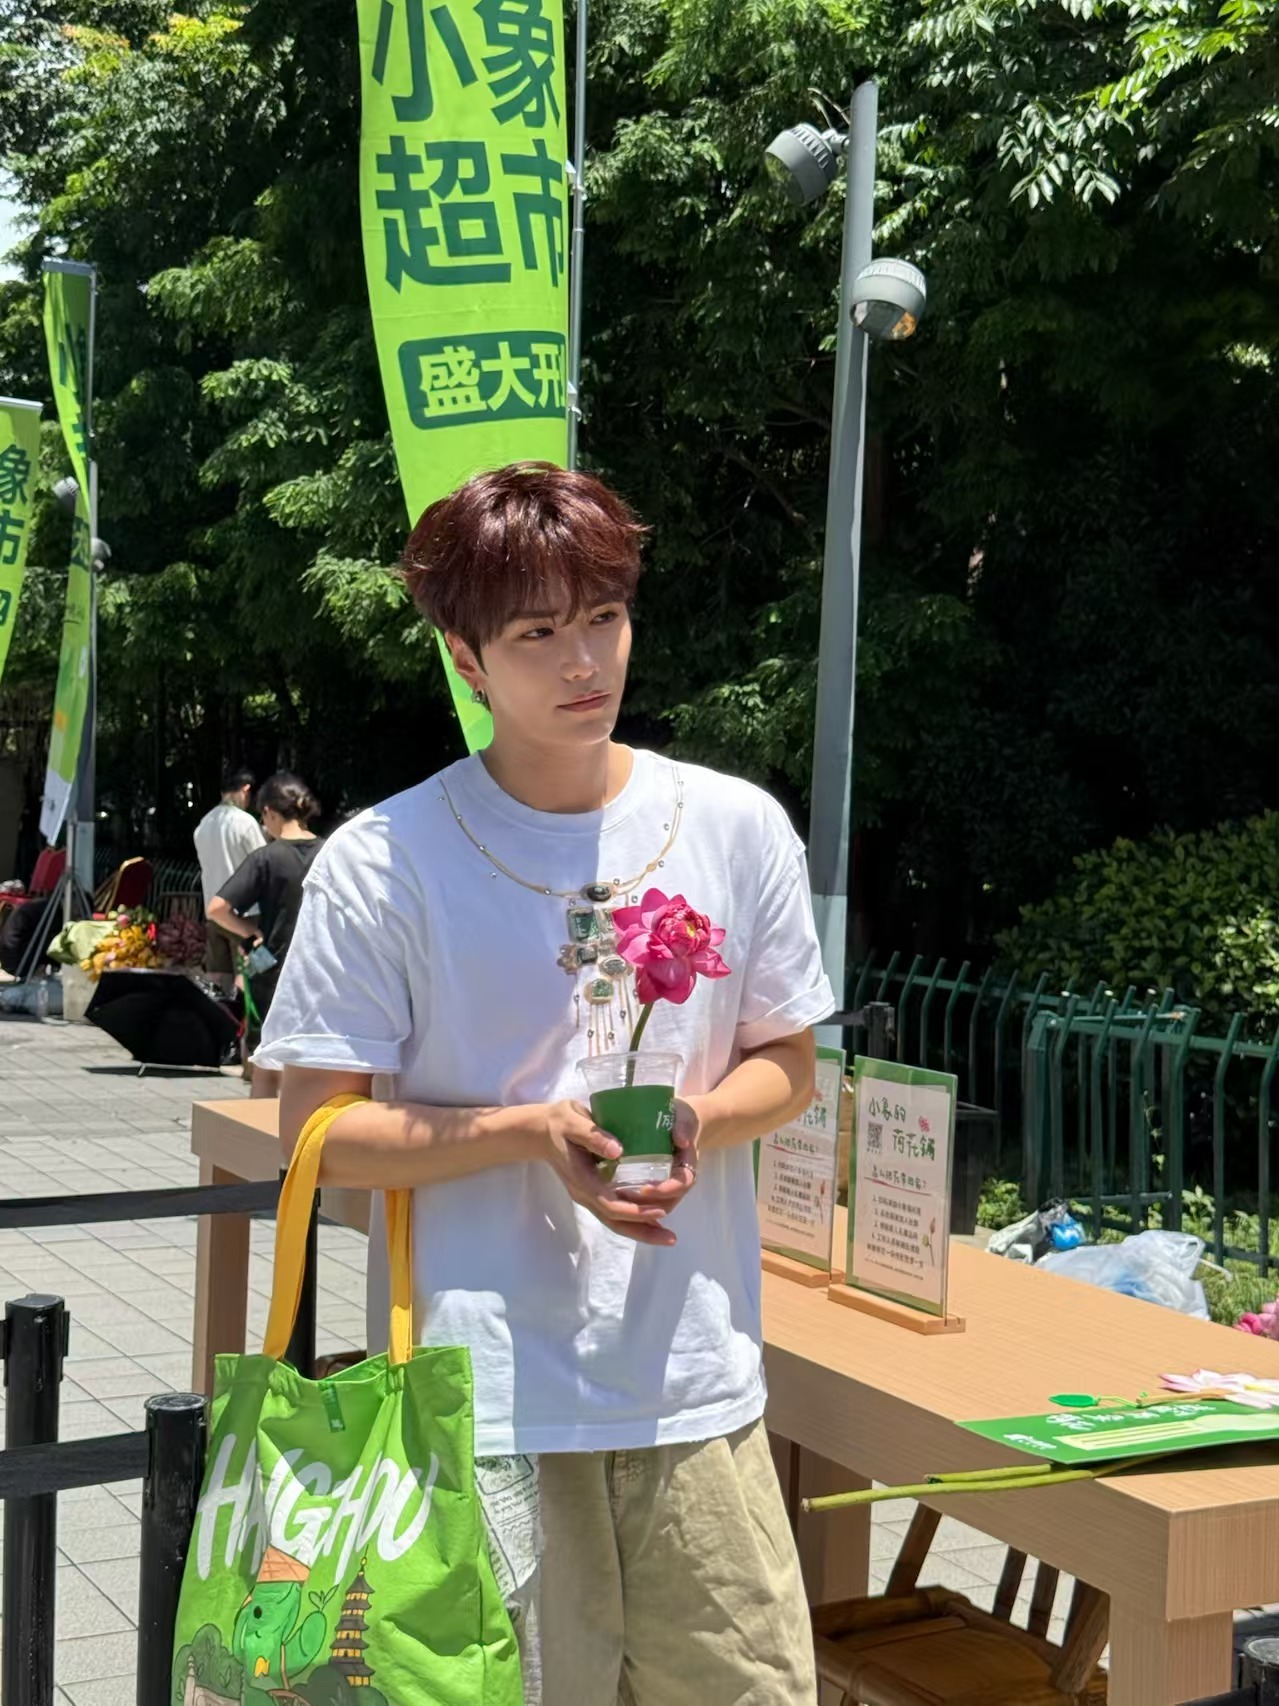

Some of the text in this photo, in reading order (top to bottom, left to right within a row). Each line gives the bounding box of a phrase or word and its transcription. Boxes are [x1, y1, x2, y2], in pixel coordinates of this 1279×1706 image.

[371, 0, 561, 129] 小象
[375, 135, 564, 295] 超市
[418, 340, 566, 418] 盛大开
